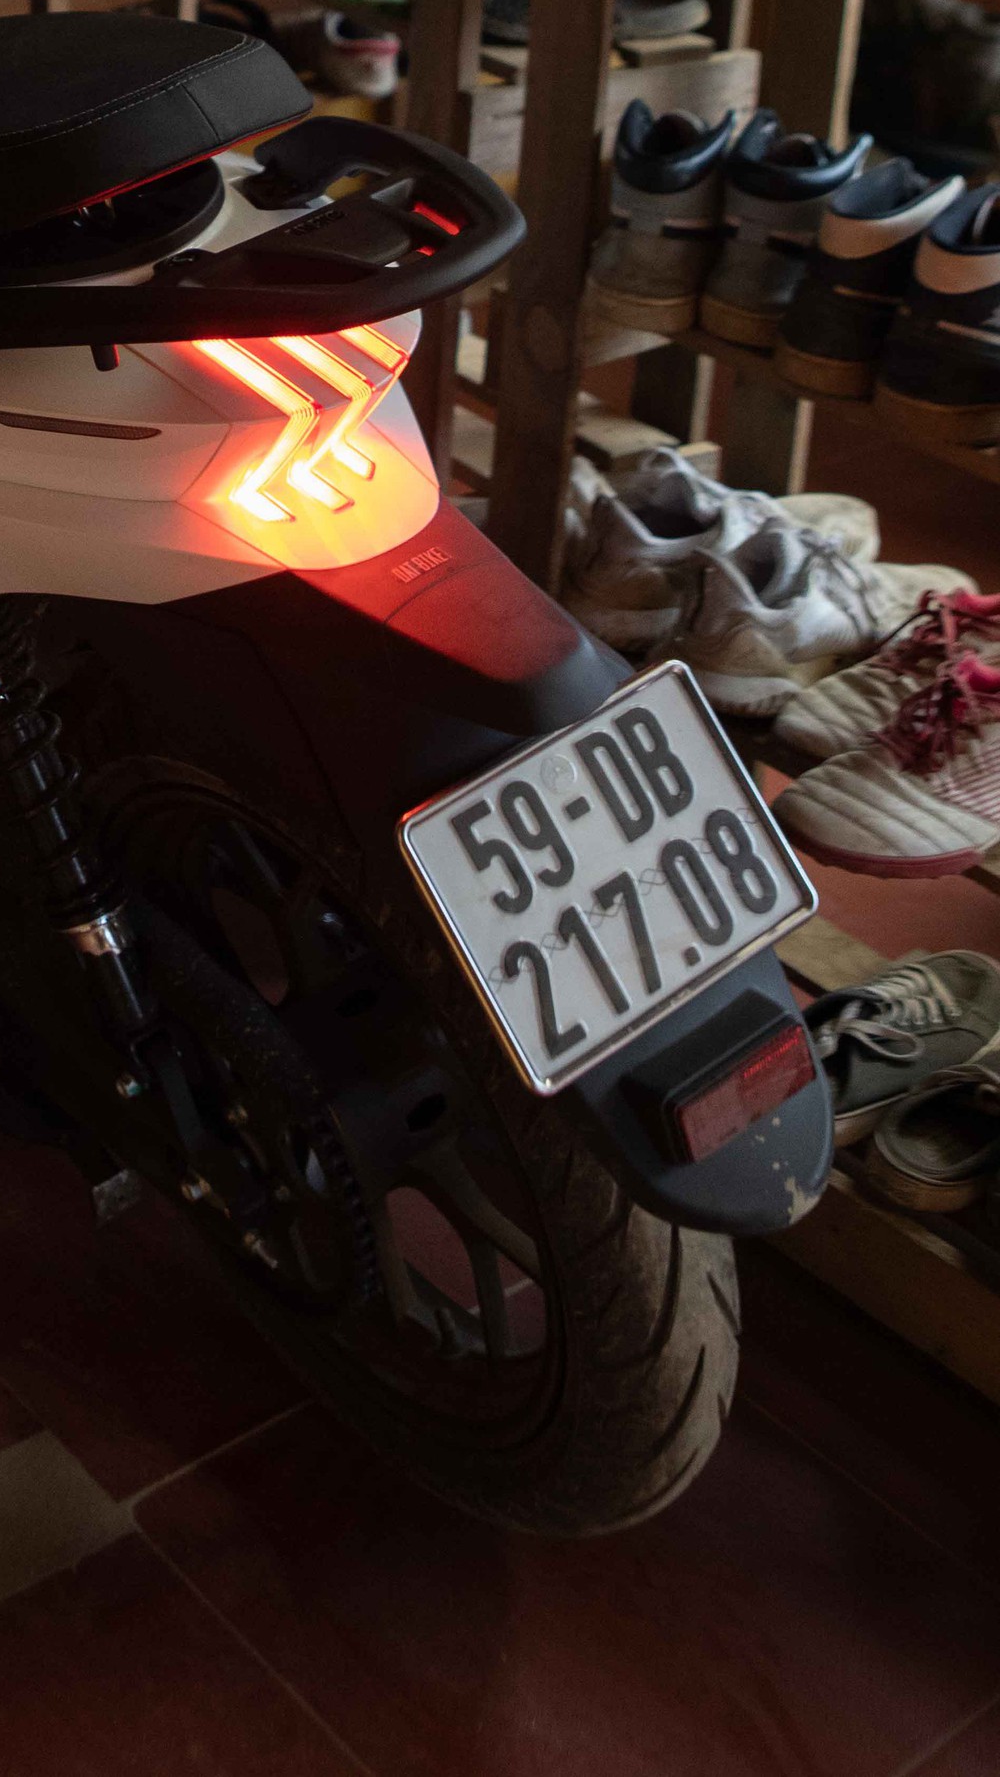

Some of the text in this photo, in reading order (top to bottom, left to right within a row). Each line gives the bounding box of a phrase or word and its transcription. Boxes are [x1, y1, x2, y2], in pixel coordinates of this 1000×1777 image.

[391, 547, 450, 583] DAT BIKE
[450, 706, 695, 915] 59-DB
[504, 809, 778, 1059] 217.08
